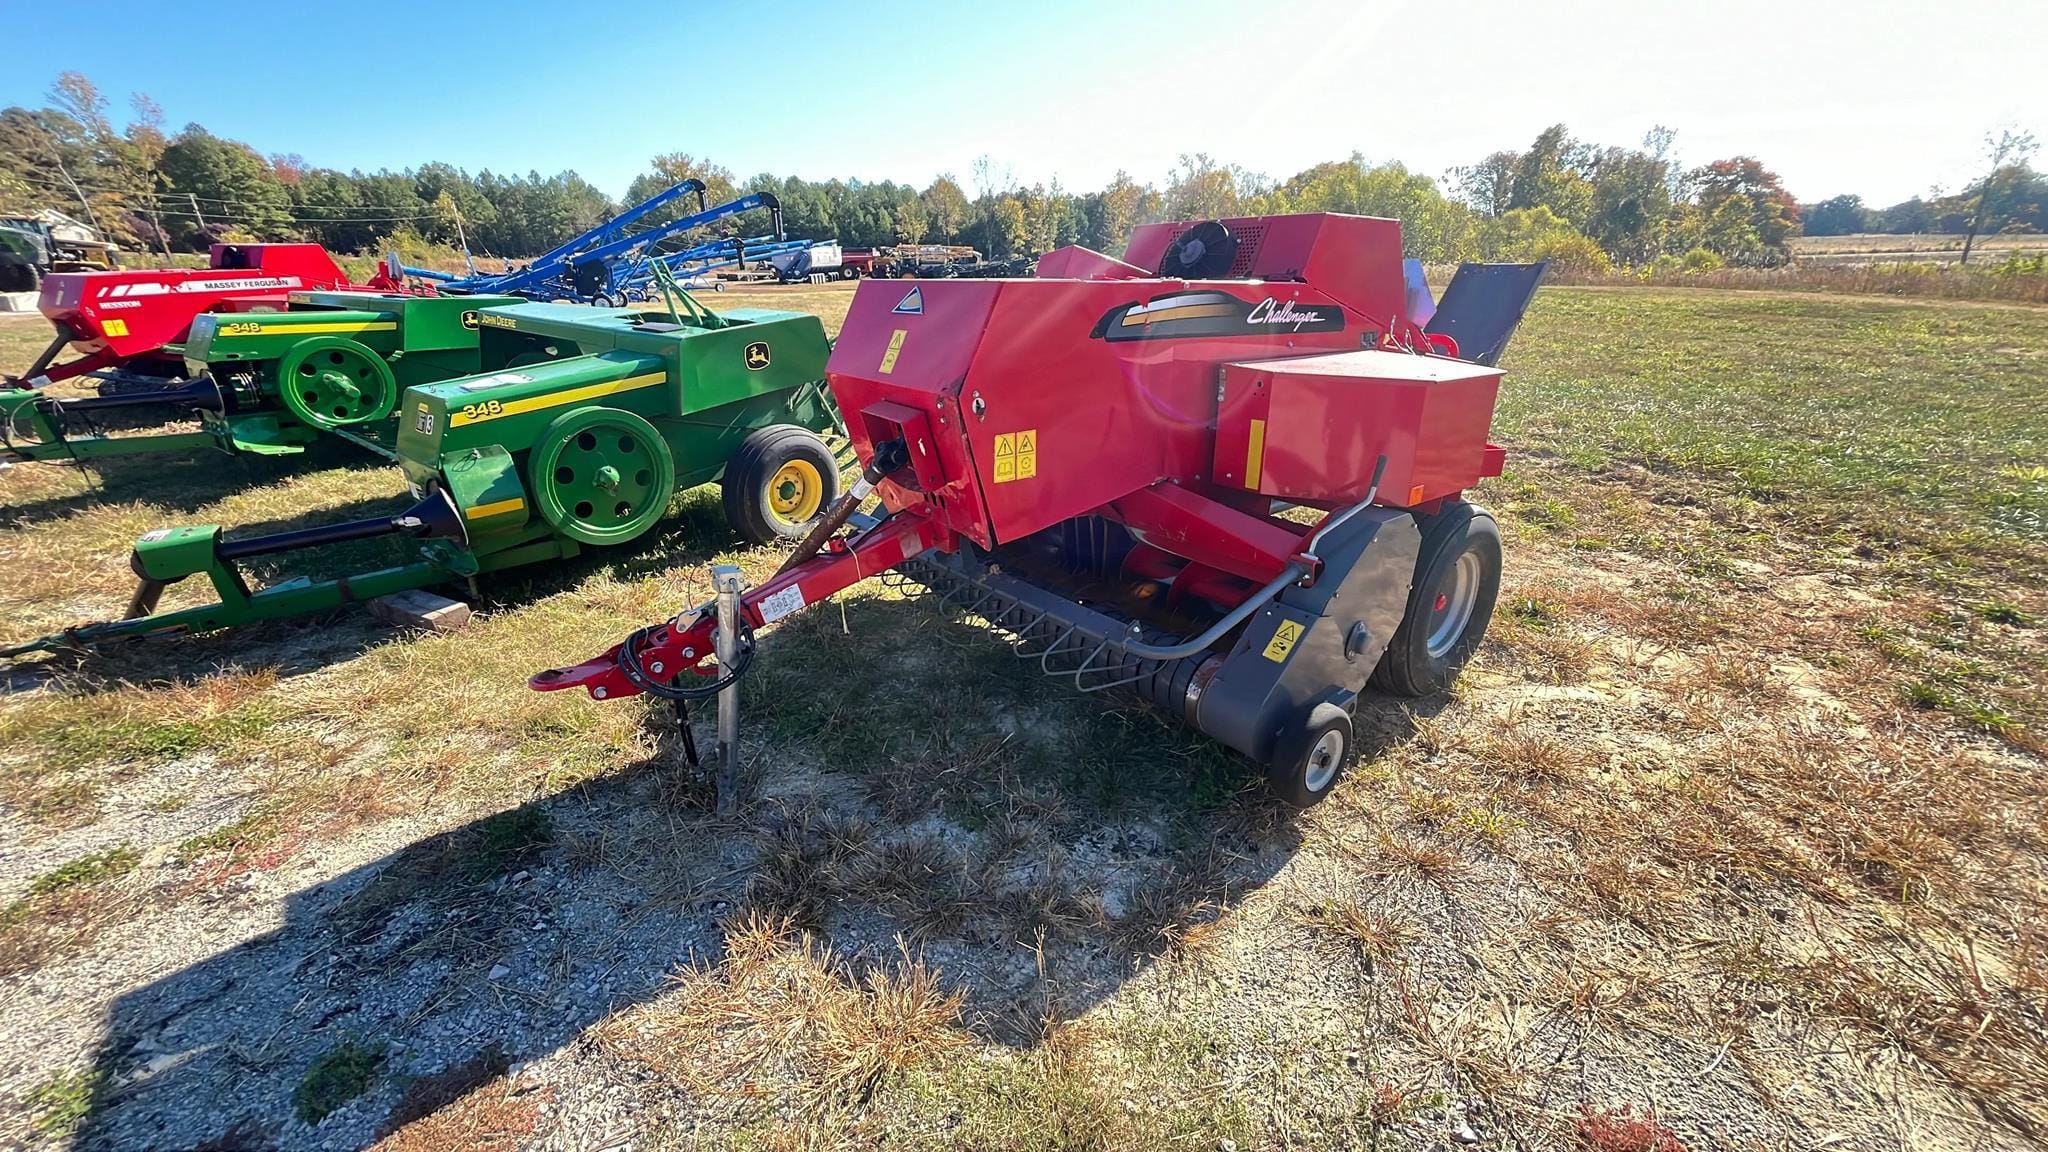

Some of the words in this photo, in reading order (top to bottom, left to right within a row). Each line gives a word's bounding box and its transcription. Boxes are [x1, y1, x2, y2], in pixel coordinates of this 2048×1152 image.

[204, 281, 241, 289] MASSEY
[244, 279, 289, 288] FERGUSON
[1246, 297, 1326, 332] Challenger
[230, 322, 261, 333] 348
[463, 400, 503, 419] 348
